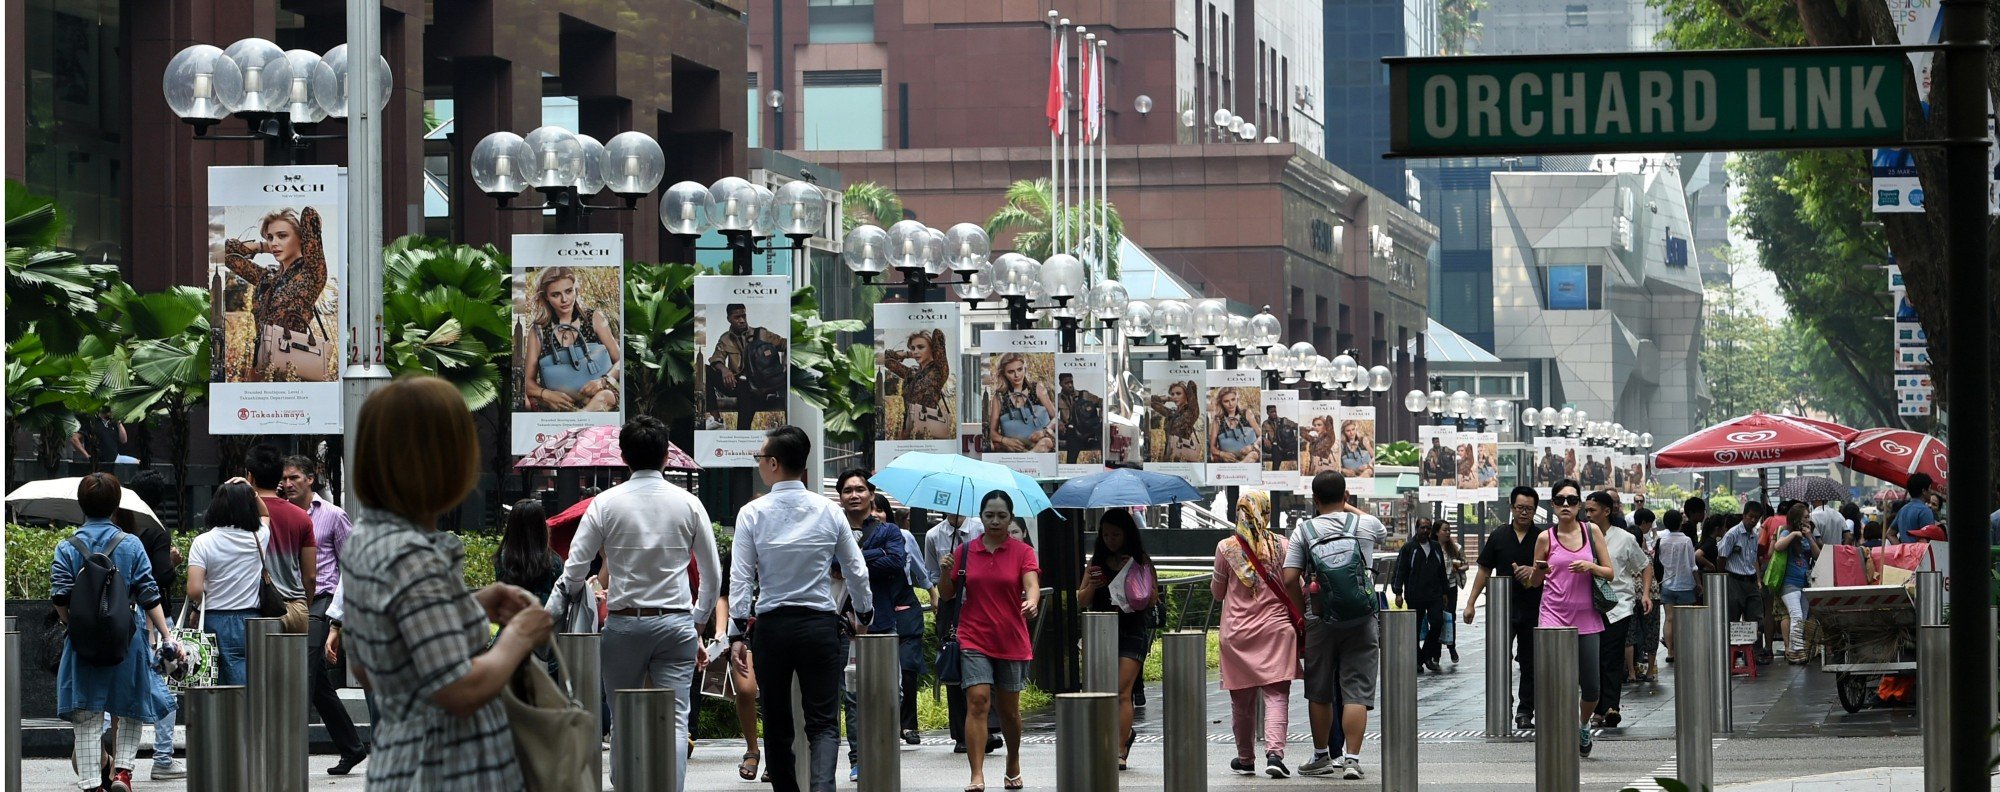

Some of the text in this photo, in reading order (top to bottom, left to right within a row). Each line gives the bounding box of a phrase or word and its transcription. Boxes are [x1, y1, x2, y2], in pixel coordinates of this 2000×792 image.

[1892, 10, 1917, 22] EPS
[1423, 65, 1887, 138] ORCHARD LINK
[262, 184, 325, 193] COACH
[250, 410, 305, 420] Takashimaya
[1741, 448, 1781, 460] WALL'S
